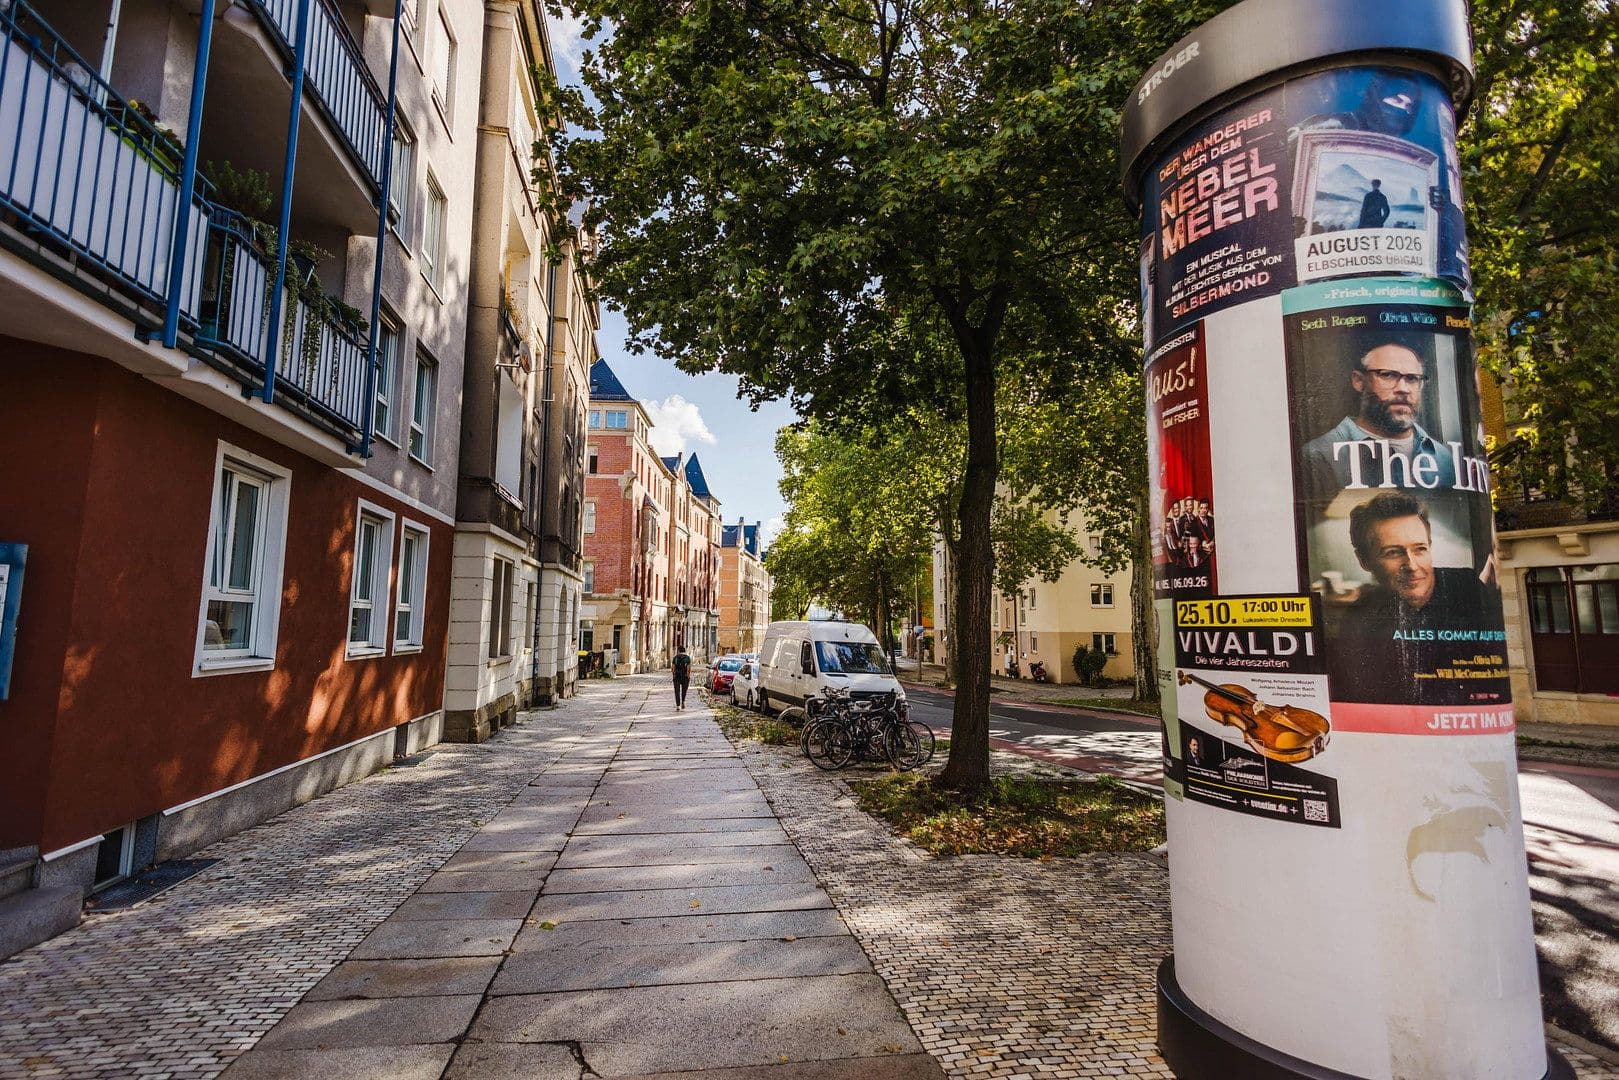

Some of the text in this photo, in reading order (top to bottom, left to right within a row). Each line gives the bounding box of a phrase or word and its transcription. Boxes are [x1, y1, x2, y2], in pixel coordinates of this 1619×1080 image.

[1159, 109, 1272, 183] DER WANDERER
[1211, 136, 1242, 160] DEM
[1161, 147, 1276, 227] NEBEL
[1162, 176, 1279, 260] MEER
[1186, 243, 1241, 273] EIN MUSICAL
[1307, 235, 1423, 258] AUGUST 2026
[1184, 274, 1197, 286] DER
[1198, 262, 1223, 278] MUSIK
[1226, 254, 1244, 267] AUS
[1246, 246, 1267, 260] DEM
[1262, 254, 1282, 267] VON
[1307, 254, 1383, 272] ELBSCHLOSS
[1172, 271, 1271, 319] SILBERMOND
[1375, 286, 1418, 298] originell
[1420, 287, 1440, 298] und
[1301, 316, 1327, 331] Seth
[1331, 314, 1368, 329] Rogen
[1379, 311, 1408, 323] Olivia
[1411, 312, 1438, 325] Wilde
[1174, 408, 1200, 424] FISHER
[1332, 439, 1440, 490] The
[1173, 576, 1208, 590] 06.09.26
[1179, 600, 1306, 625] 25.10. 17:00 Uhr
[1280, 616, 1307, 624] Dresden
[1178, 631, 1316, 657] VIVALDI
[1392, 629, 1435, 641] ALLES
[1437, 629, 1478, 641] KOMMT
[1479, 630, 1493, 641] AUF
[1195, 655, 1290, 669] Die vier Jahreszeiten
[1426, 712, 1478, 729] JETZT
[1480, 711, 1498, 728] IM
